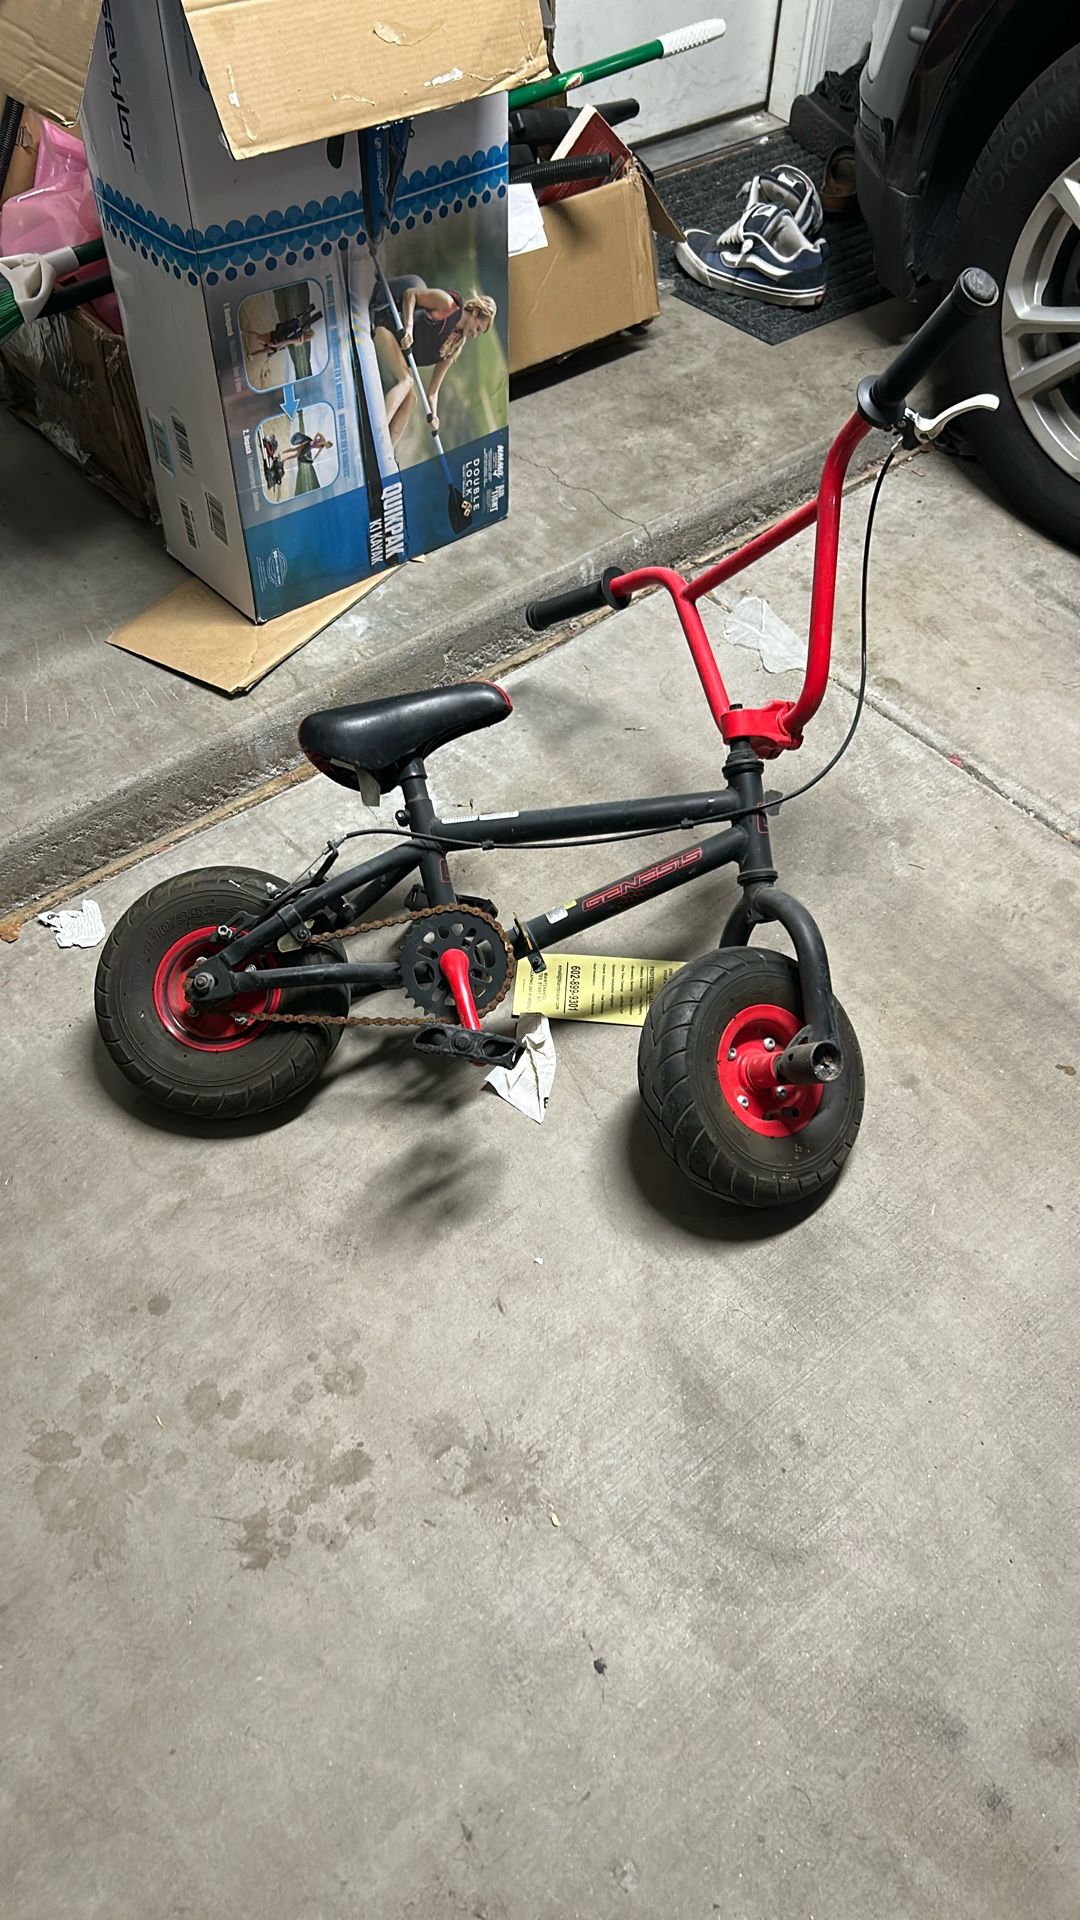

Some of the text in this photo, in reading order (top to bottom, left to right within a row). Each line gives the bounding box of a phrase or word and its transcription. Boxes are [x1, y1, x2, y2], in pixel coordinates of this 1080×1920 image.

[102, 0, 137, 173] sevylor
[465, 461, 473, 496] LOCK
[381, 482, 404, 559] QUIKPAK
[490, 491, 499, 512] TIGHT
[370, 532, 384, 566] KAYAK
[568, 965, 581, 1011] 602-899-9301
